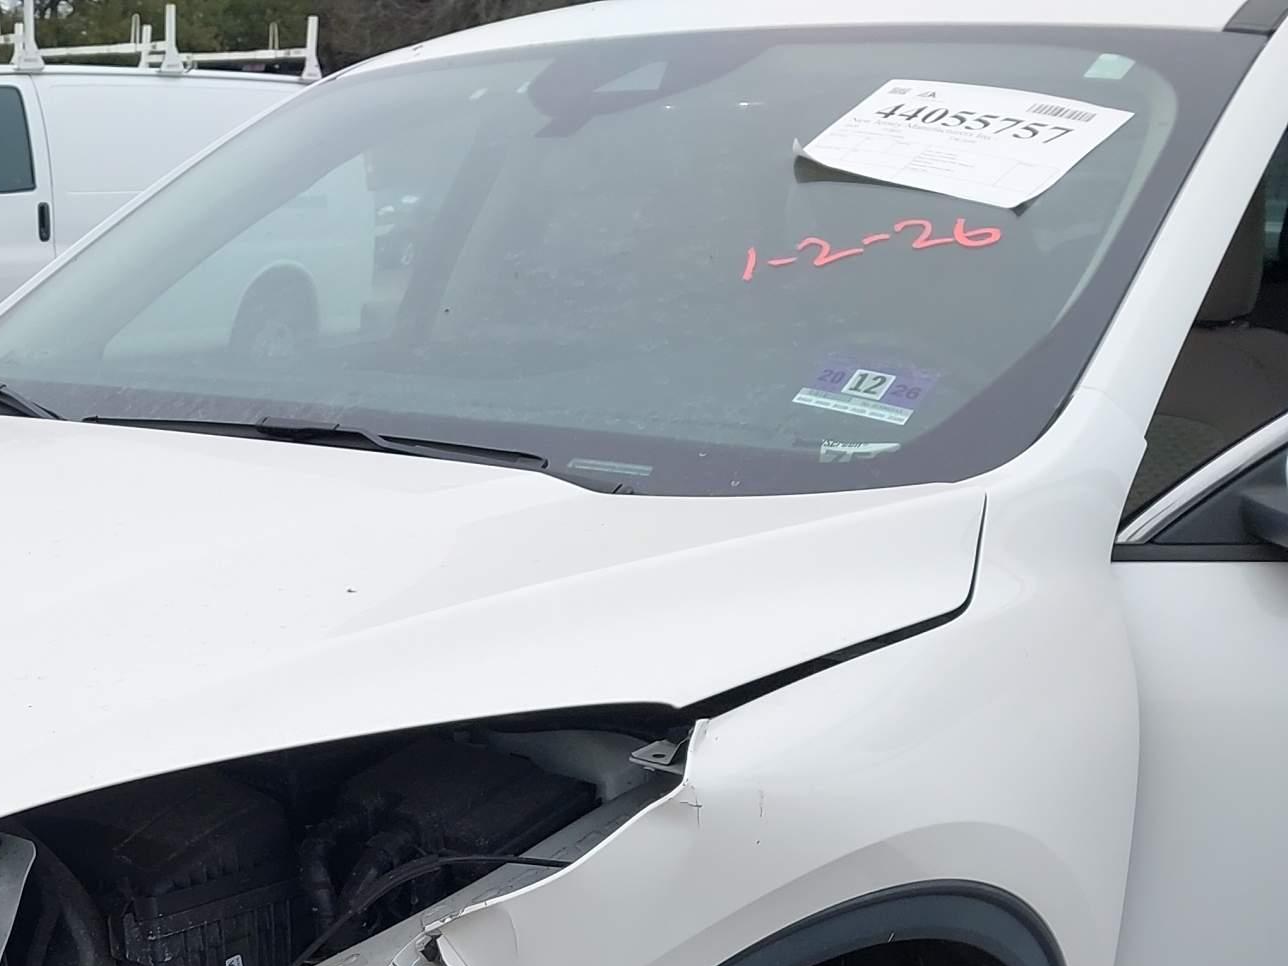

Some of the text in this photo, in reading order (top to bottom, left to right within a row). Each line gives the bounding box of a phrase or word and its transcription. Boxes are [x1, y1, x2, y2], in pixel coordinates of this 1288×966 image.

[874, 103, 1075, 144] 44055757
[849, 372, 887, 395] 12
[890, 384, 922, 400] 26
